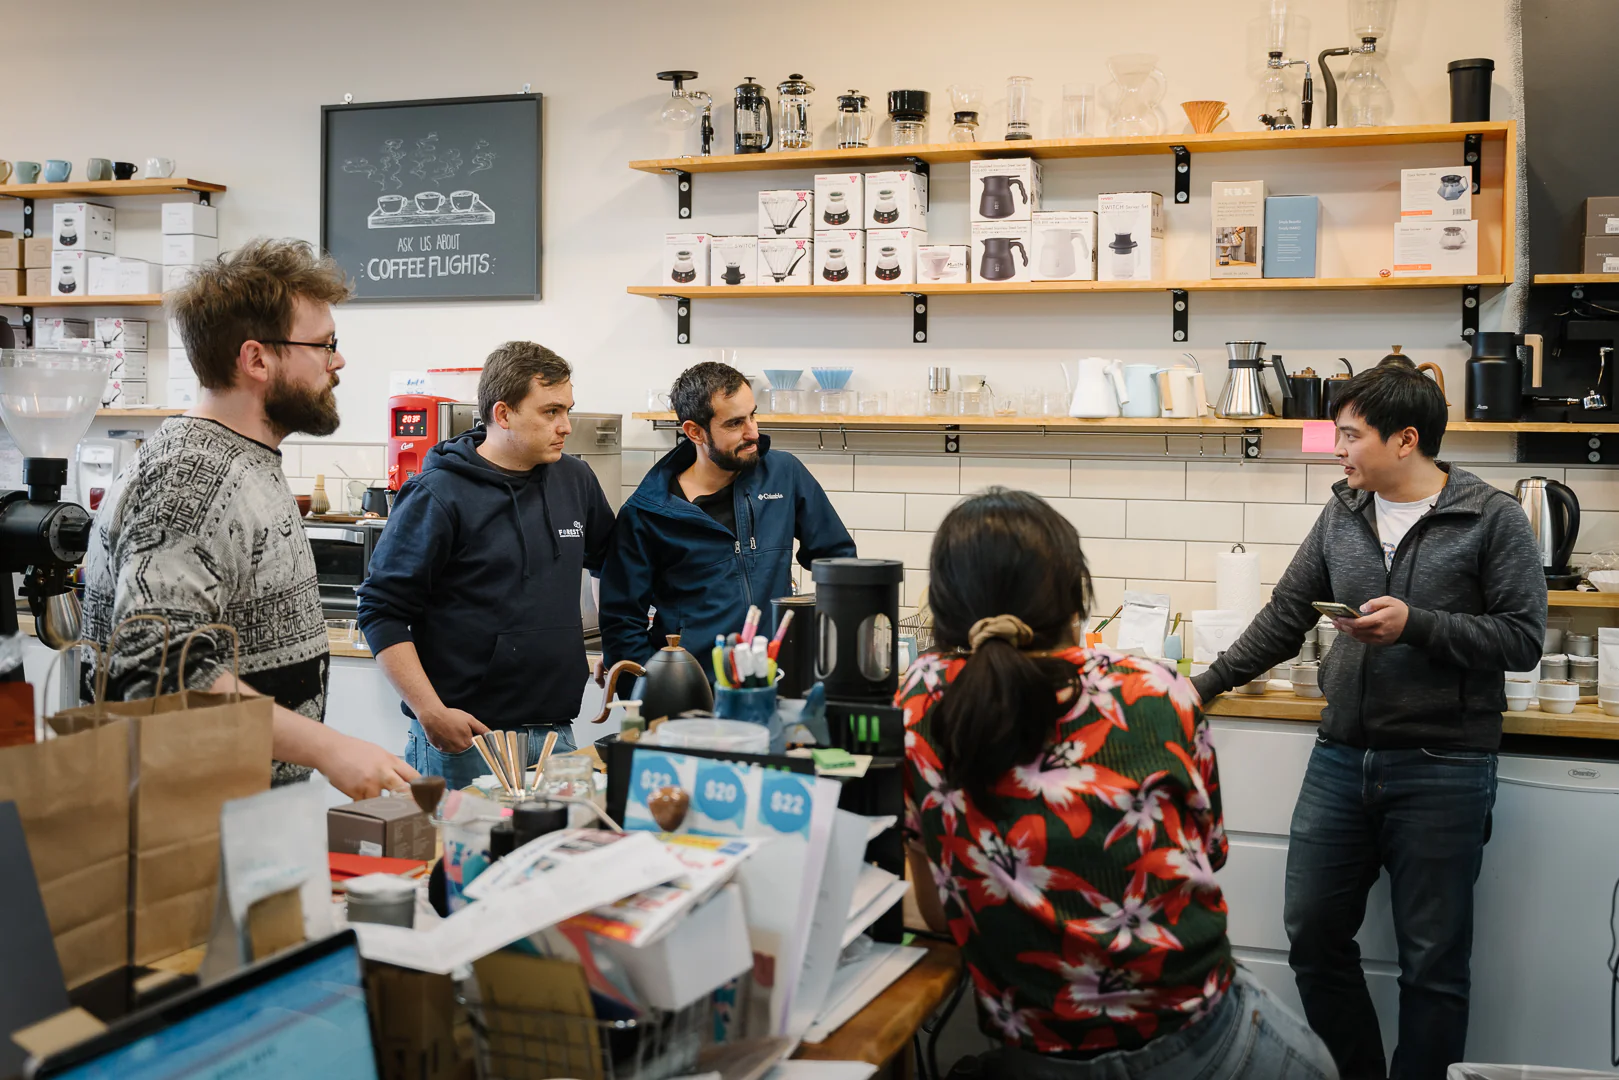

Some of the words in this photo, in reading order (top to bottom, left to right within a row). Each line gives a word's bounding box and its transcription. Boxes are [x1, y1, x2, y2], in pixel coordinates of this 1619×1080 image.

[397, 237, 413, 252] ASK
[420, 236, 432, 251] US
[436, 233, 461, 250] ABOUT
[367, 257, 425, 281] COFFEE
[428, 253, 490, 278] FLIGHTS
[704, 780, 737, 803] $20
[770, 790, 805, 815] $22
